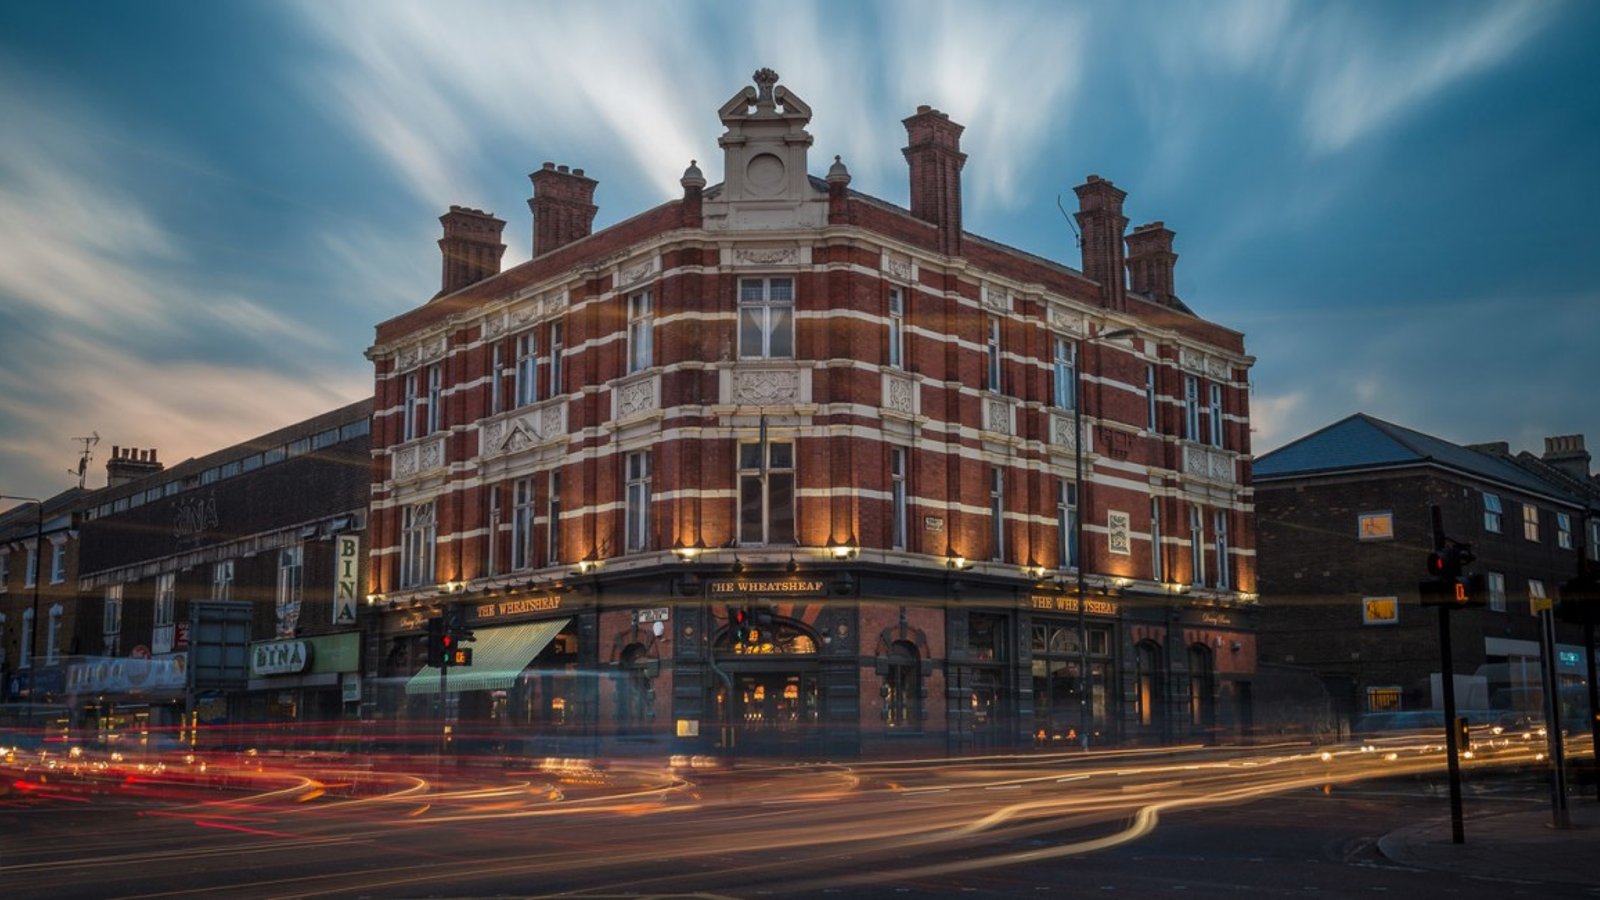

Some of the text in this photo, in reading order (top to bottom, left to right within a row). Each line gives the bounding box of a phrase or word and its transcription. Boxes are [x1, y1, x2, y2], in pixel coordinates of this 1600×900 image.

[339, 539, 356, 620] BINA
[738, 581, 823, 593] WHEATSHEAF
[478, 596, 561, 618] THE WHEATSHEAF
[1032, 596, 1117, 614] THE WHETSHEAF
[255, 645, 303, 668] BINA
